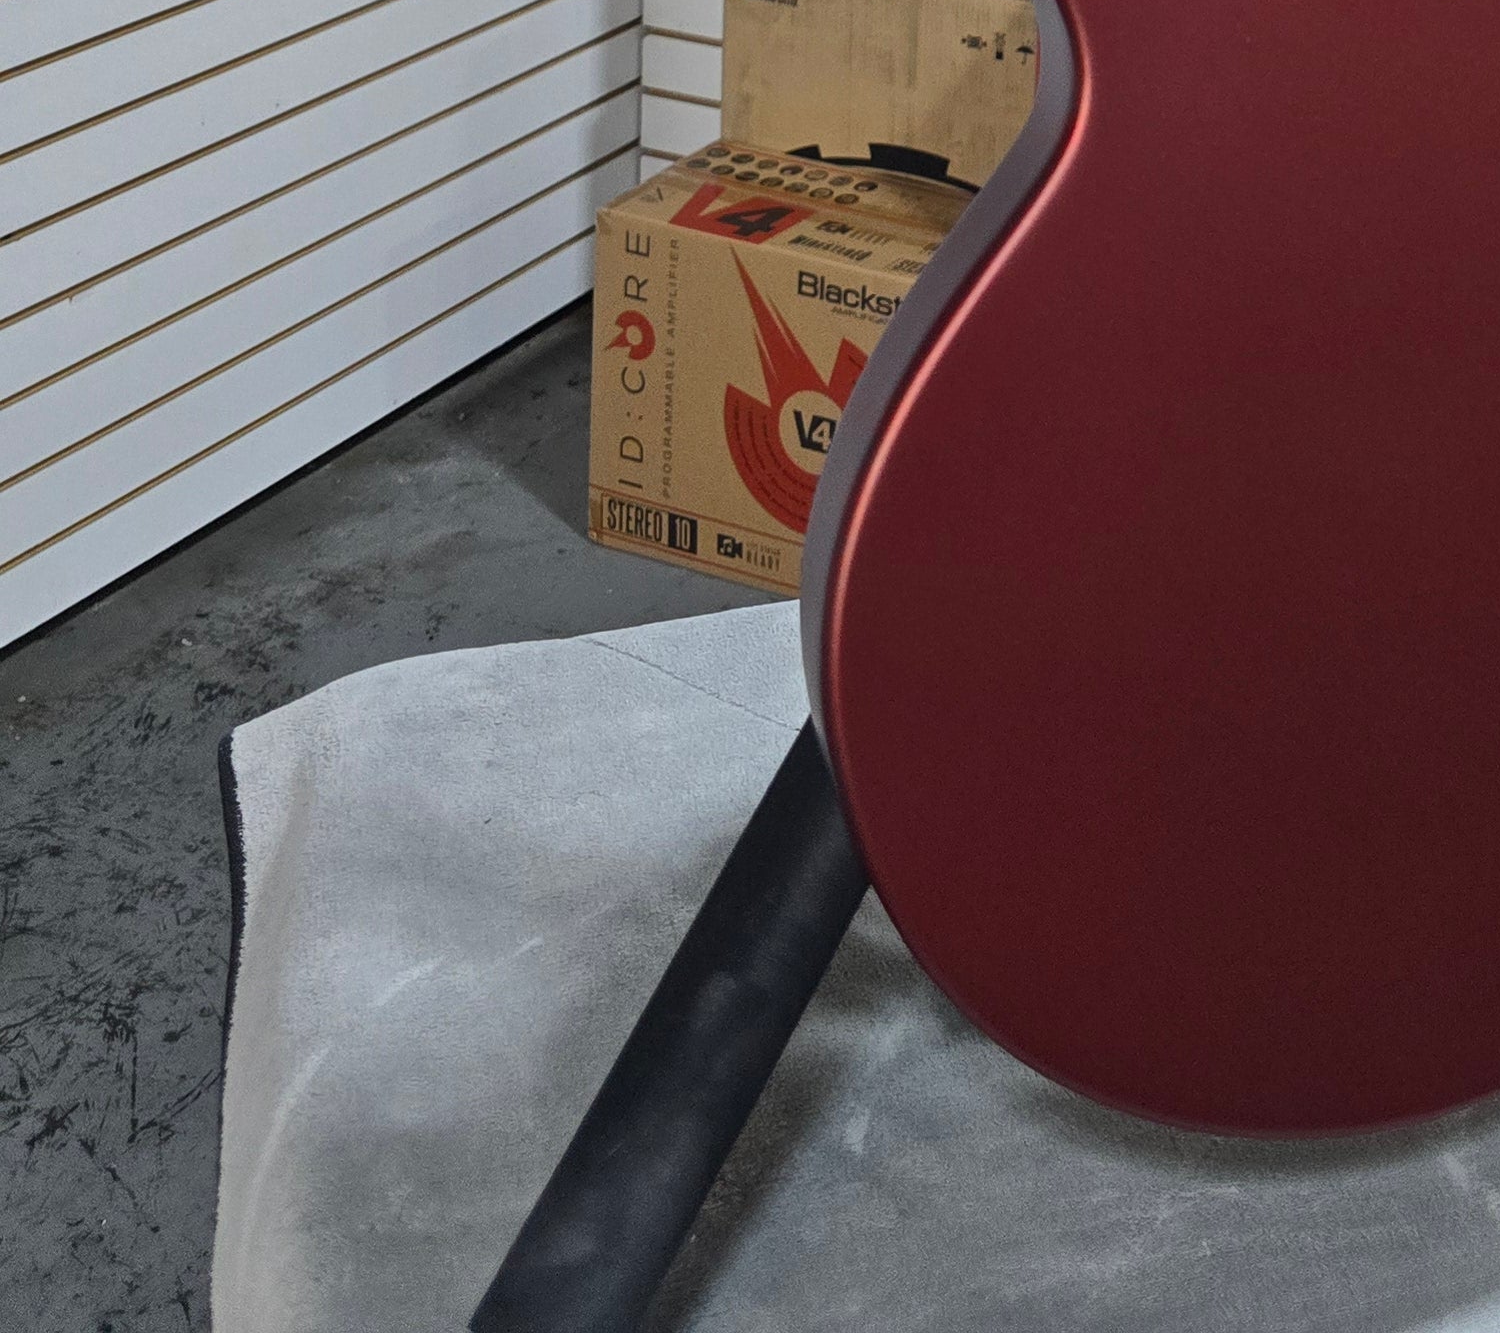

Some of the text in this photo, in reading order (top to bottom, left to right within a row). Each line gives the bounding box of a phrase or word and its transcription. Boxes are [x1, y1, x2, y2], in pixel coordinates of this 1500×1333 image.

[662, 238, 680, 499] PROGRAMMABLE AMPLIFIER
[607, 498, 691, 550] STEREO 10
